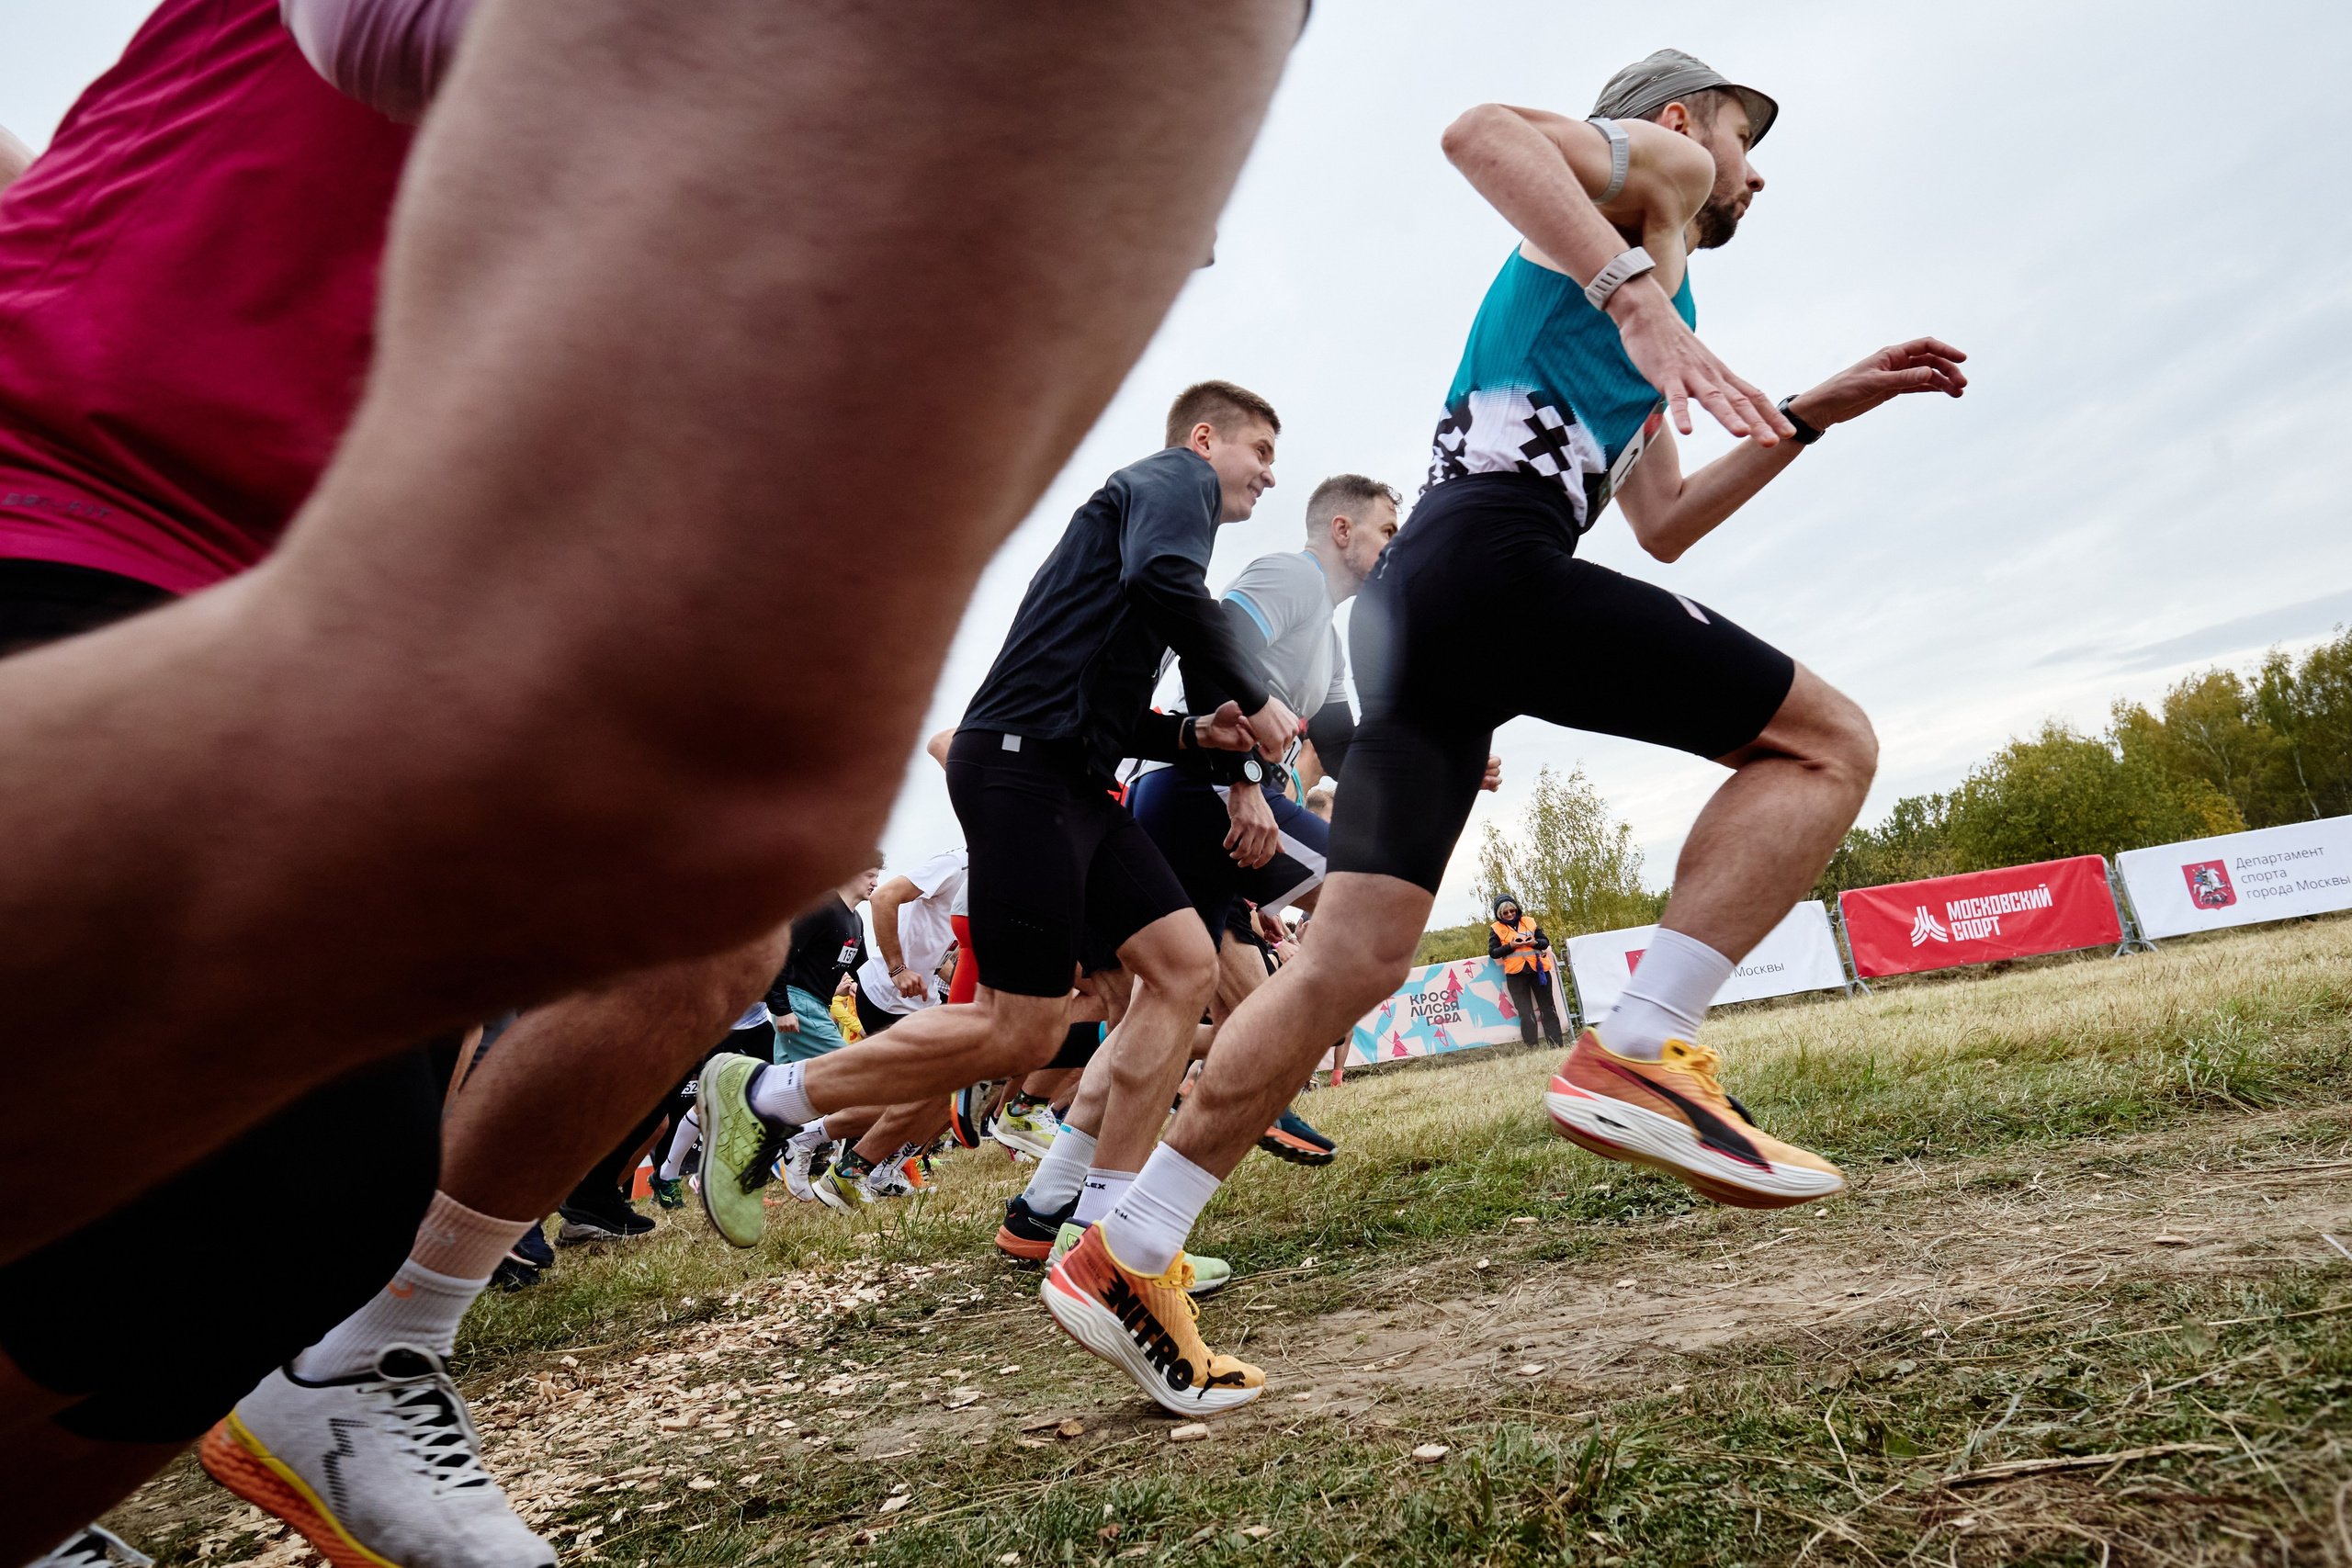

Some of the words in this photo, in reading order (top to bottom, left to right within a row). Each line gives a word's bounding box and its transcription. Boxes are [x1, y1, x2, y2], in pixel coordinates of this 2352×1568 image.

[2236, 847, 2324, 870] Департамент
[2241, 869, 2288, 884] спорта
[2246, 884, 2294, 899] города
[2296, 875, 2351, 892] Москвы
[1946, 884, 2053, 921] МОСКОВСКИЙ
[1951, 916, 2001, 942] СПОРТ
[1734, 963, 1785, 978] Москвы
[1409, 989, 1458, 1006] КРОСС
[1410, 1000, 1460, 1018] ЛИСЬЯ
[1426, 1011, 1463, 1027] ГОРА
[1098, 1264, 1194, 1392] NITRO
